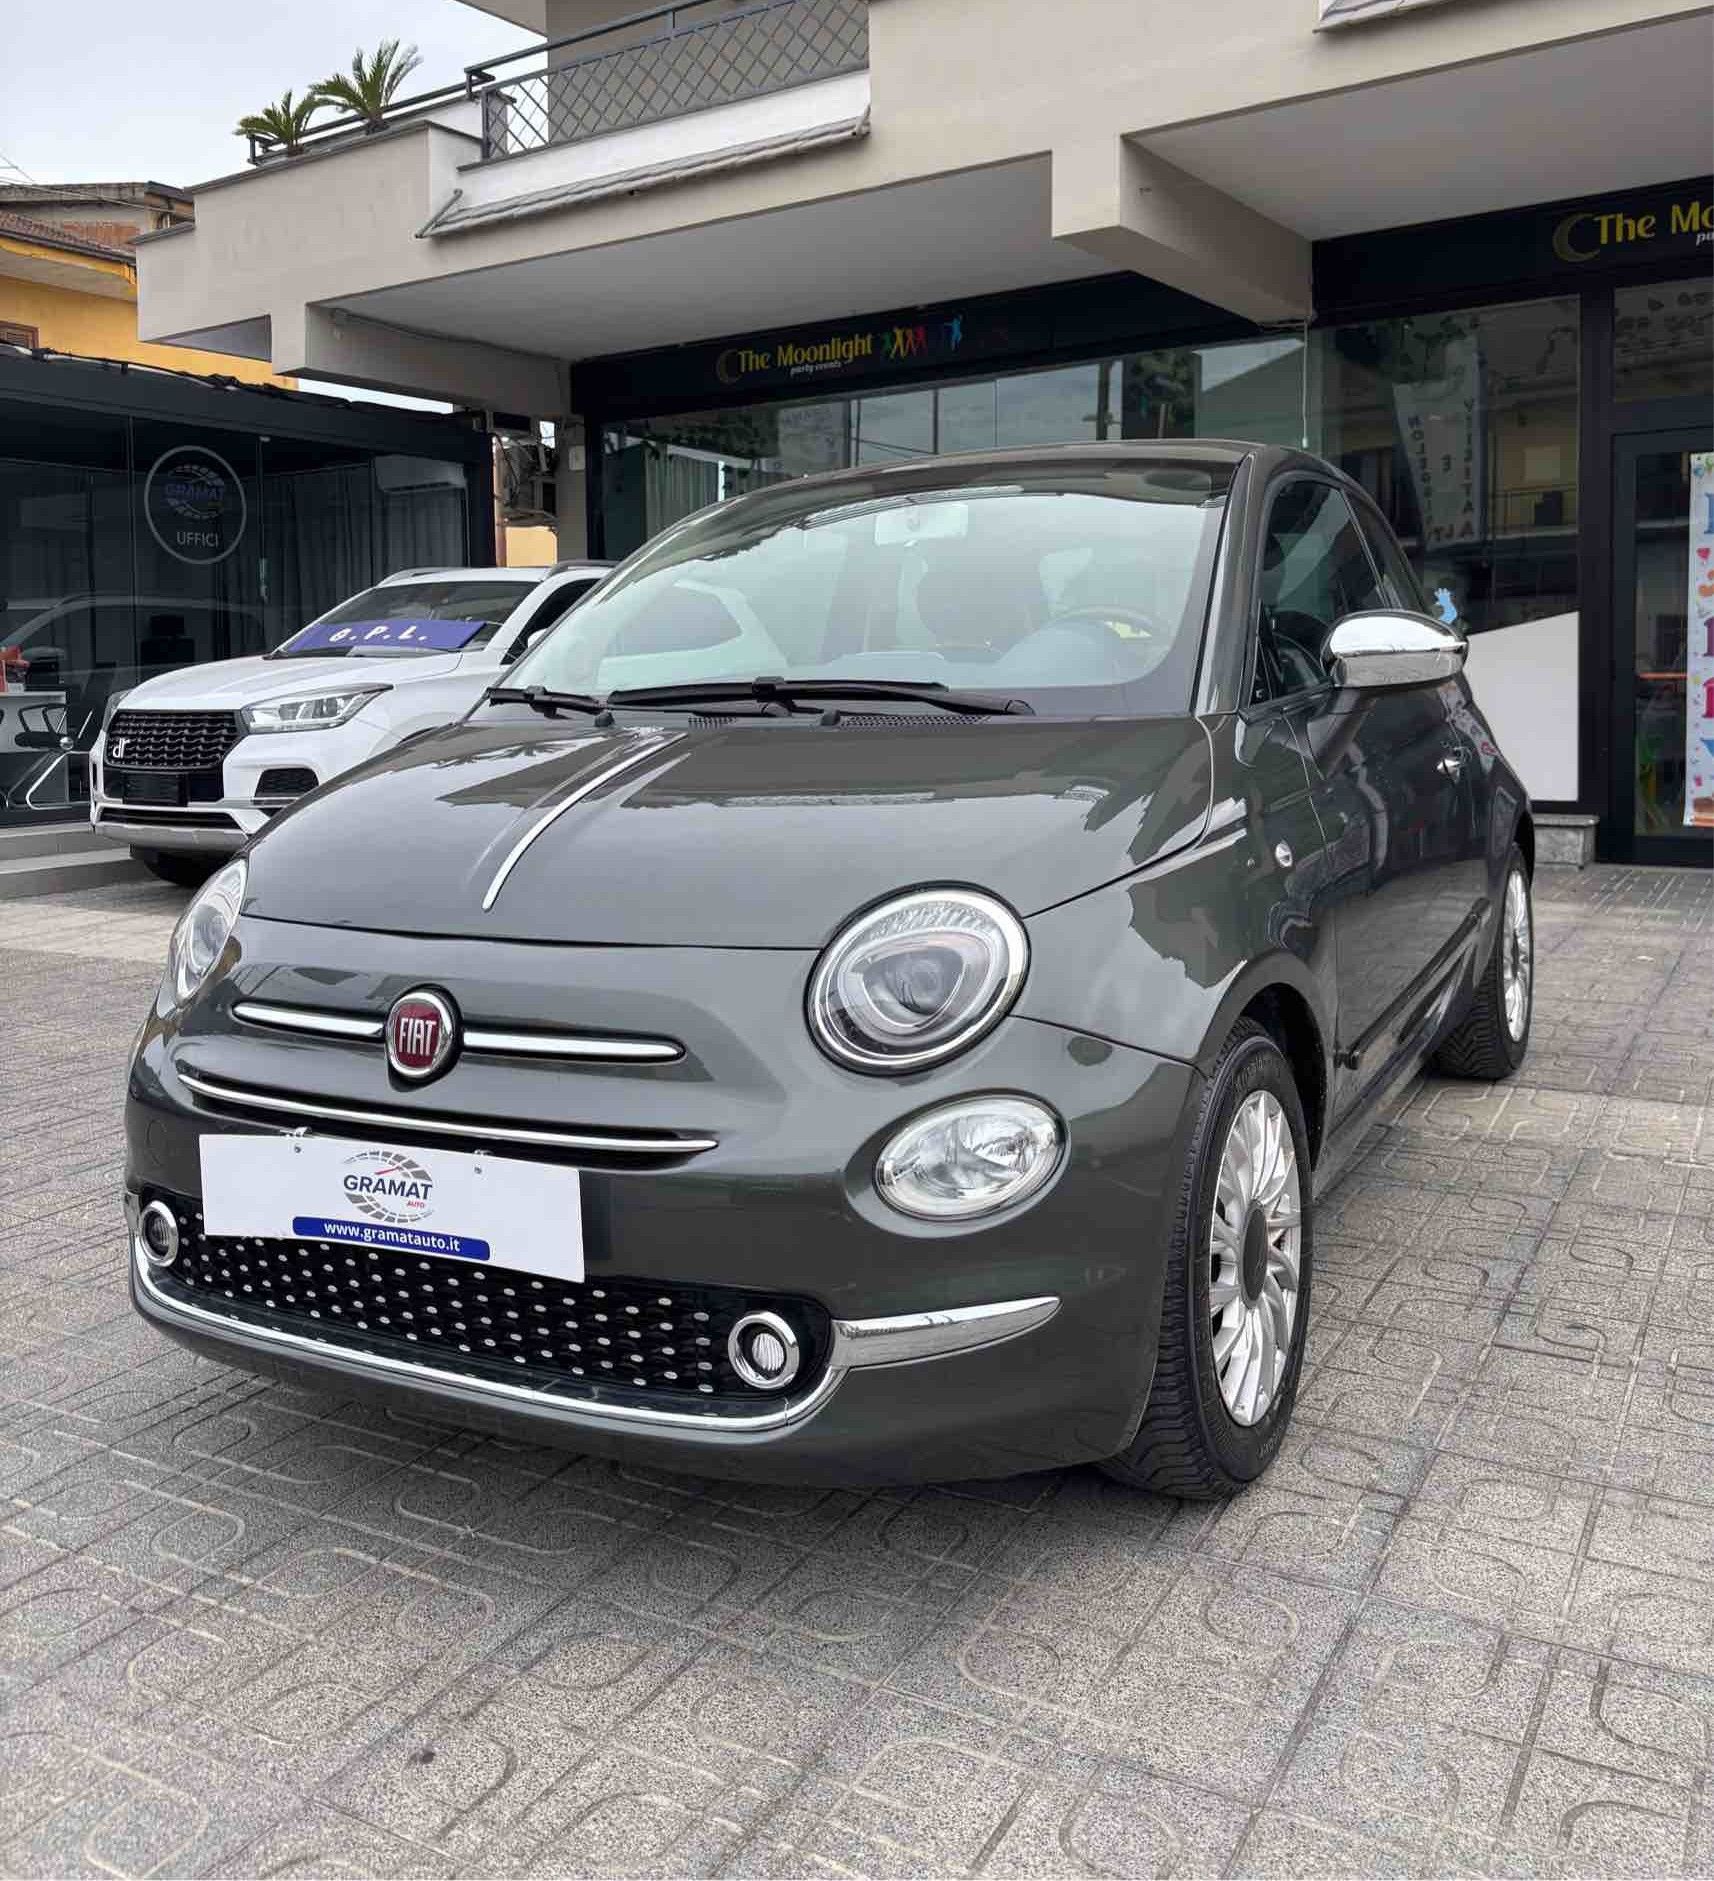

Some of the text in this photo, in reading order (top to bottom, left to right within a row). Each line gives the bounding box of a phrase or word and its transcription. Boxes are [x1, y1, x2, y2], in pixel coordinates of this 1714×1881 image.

[1592, 211, 1657, 245] The
[737, 333, 873, 373] The Moonlight
[176, 530, 219, 548] UFFICI
[398, 1017, 437, 1056] FIAT
[343, 1173, 433, 1201] GRAMAT
[406, 1199, 426, 1209] AUTO
[323, 1220, 461, 1253] www.gramatauto.it
